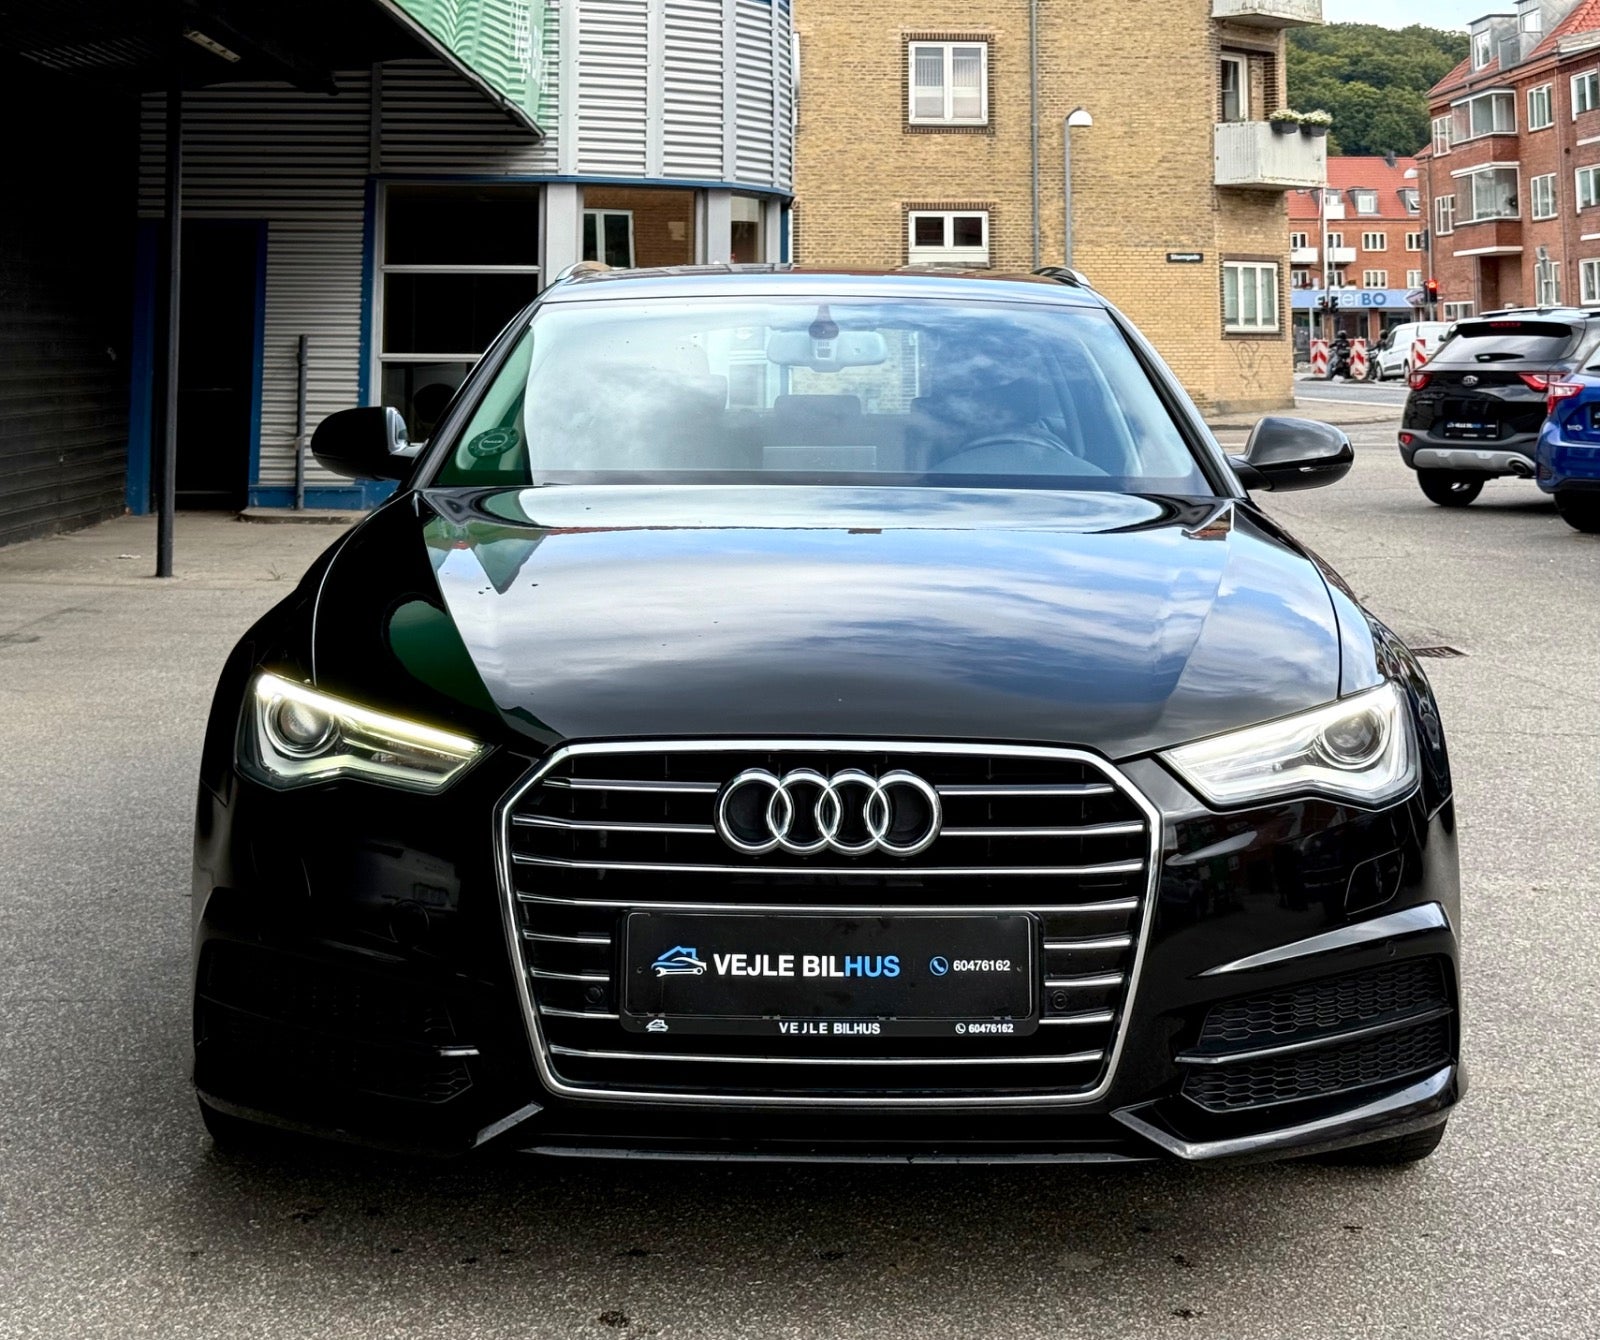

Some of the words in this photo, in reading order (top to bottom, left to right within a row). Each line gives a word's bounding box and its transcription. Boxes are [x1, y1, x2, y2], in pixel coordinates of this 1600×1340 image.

[713, 953, 795, 977] VEJLE
[802, 955, 900, 978] BILHUS
[953, 959, 1011, 971] 60476162
[779, 1022, 828, 1034] VEJLE
[833, 1022, 881, 1034] BILHUS
[968, 1023, 1014, 1033] 60476162
